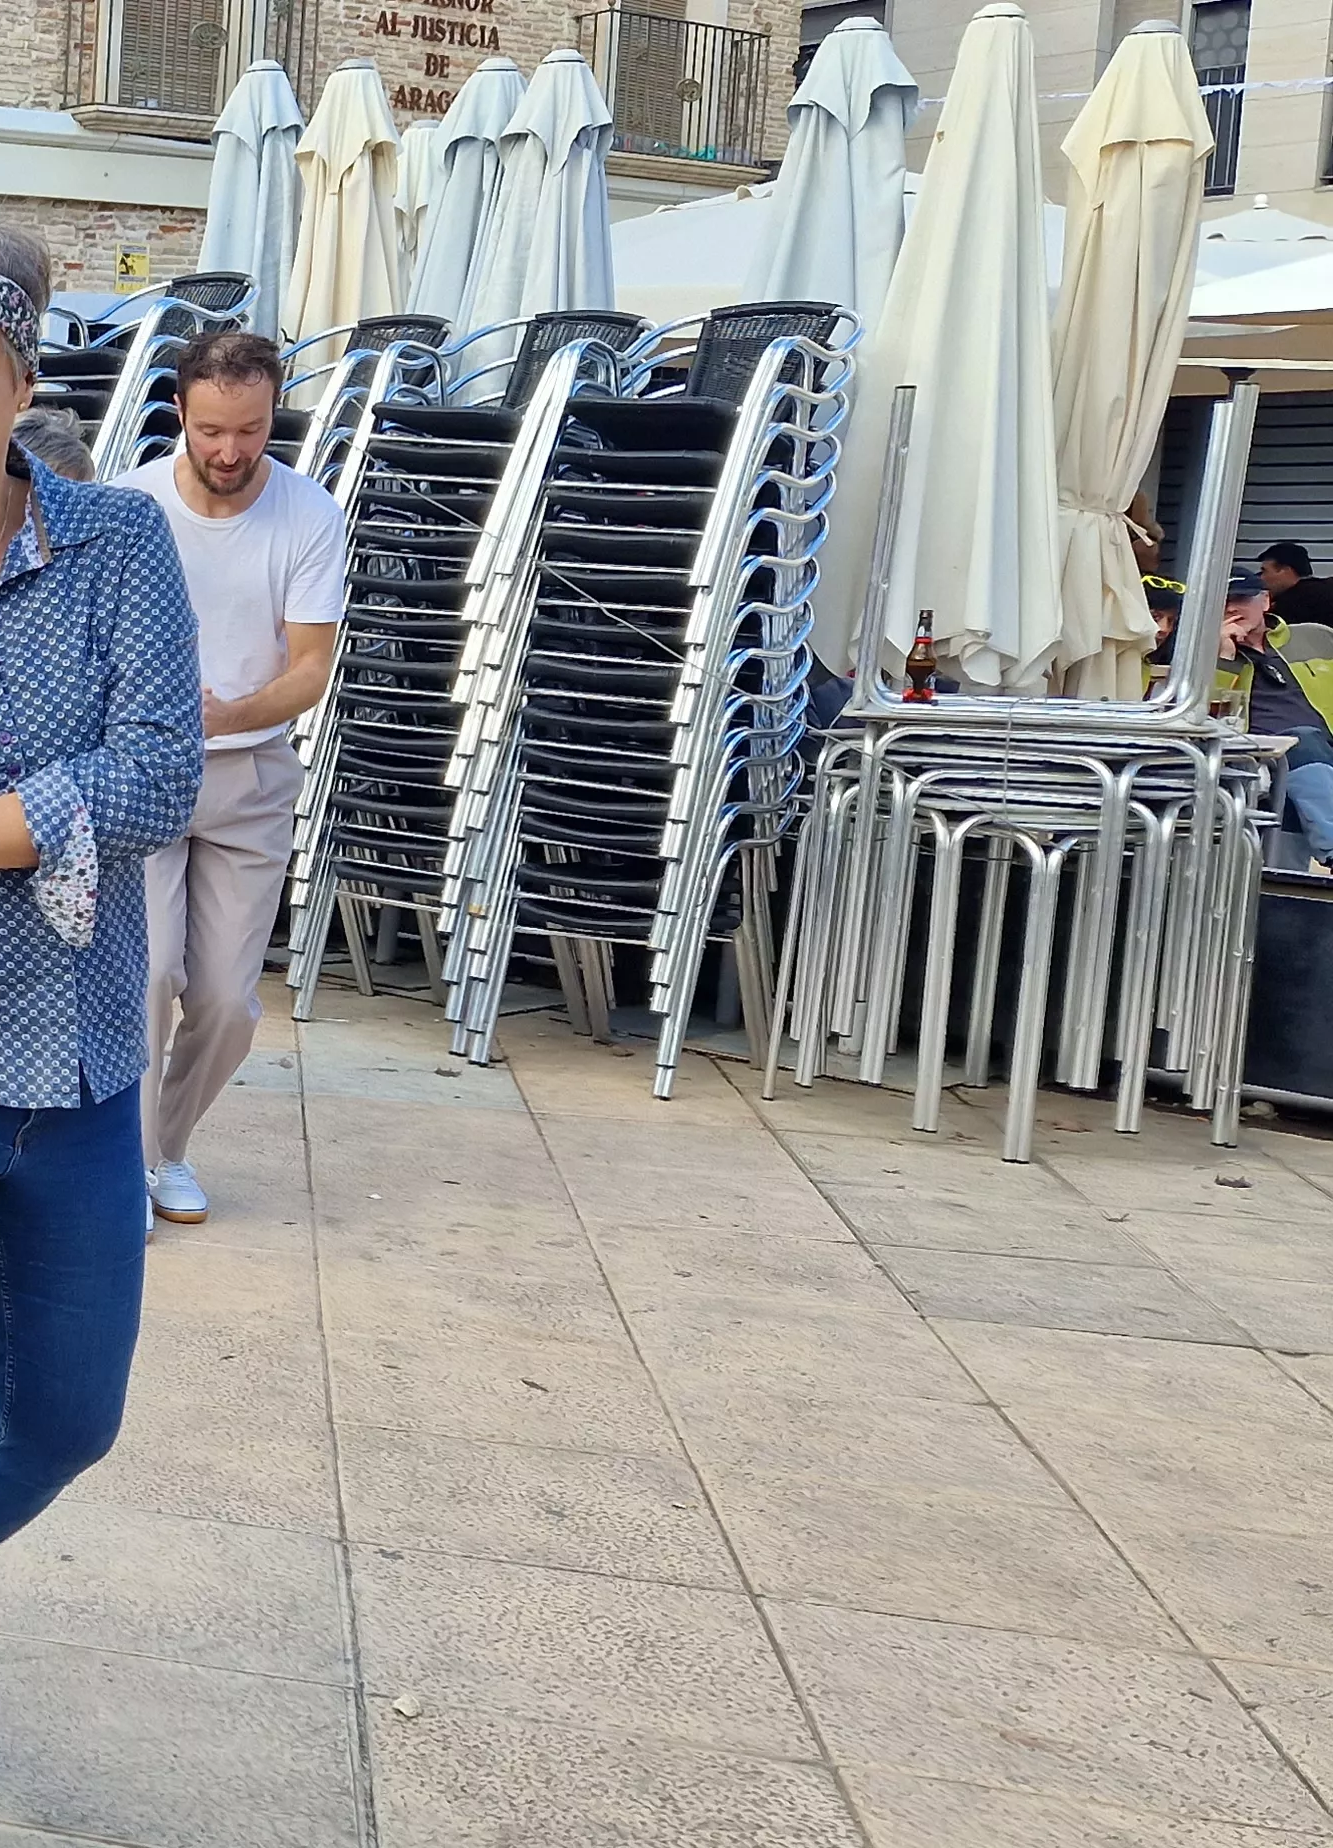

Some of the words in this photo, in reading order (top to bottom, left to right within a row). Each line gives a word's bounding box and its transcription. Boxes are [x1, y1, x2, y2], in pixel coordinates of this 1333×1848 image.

[375, 10, 401, 37] AL
[411, 14, 500, 50] JUSTICIA
[424, 52, 450, 79] DE
[393, 84, 459, 114] ARAG
